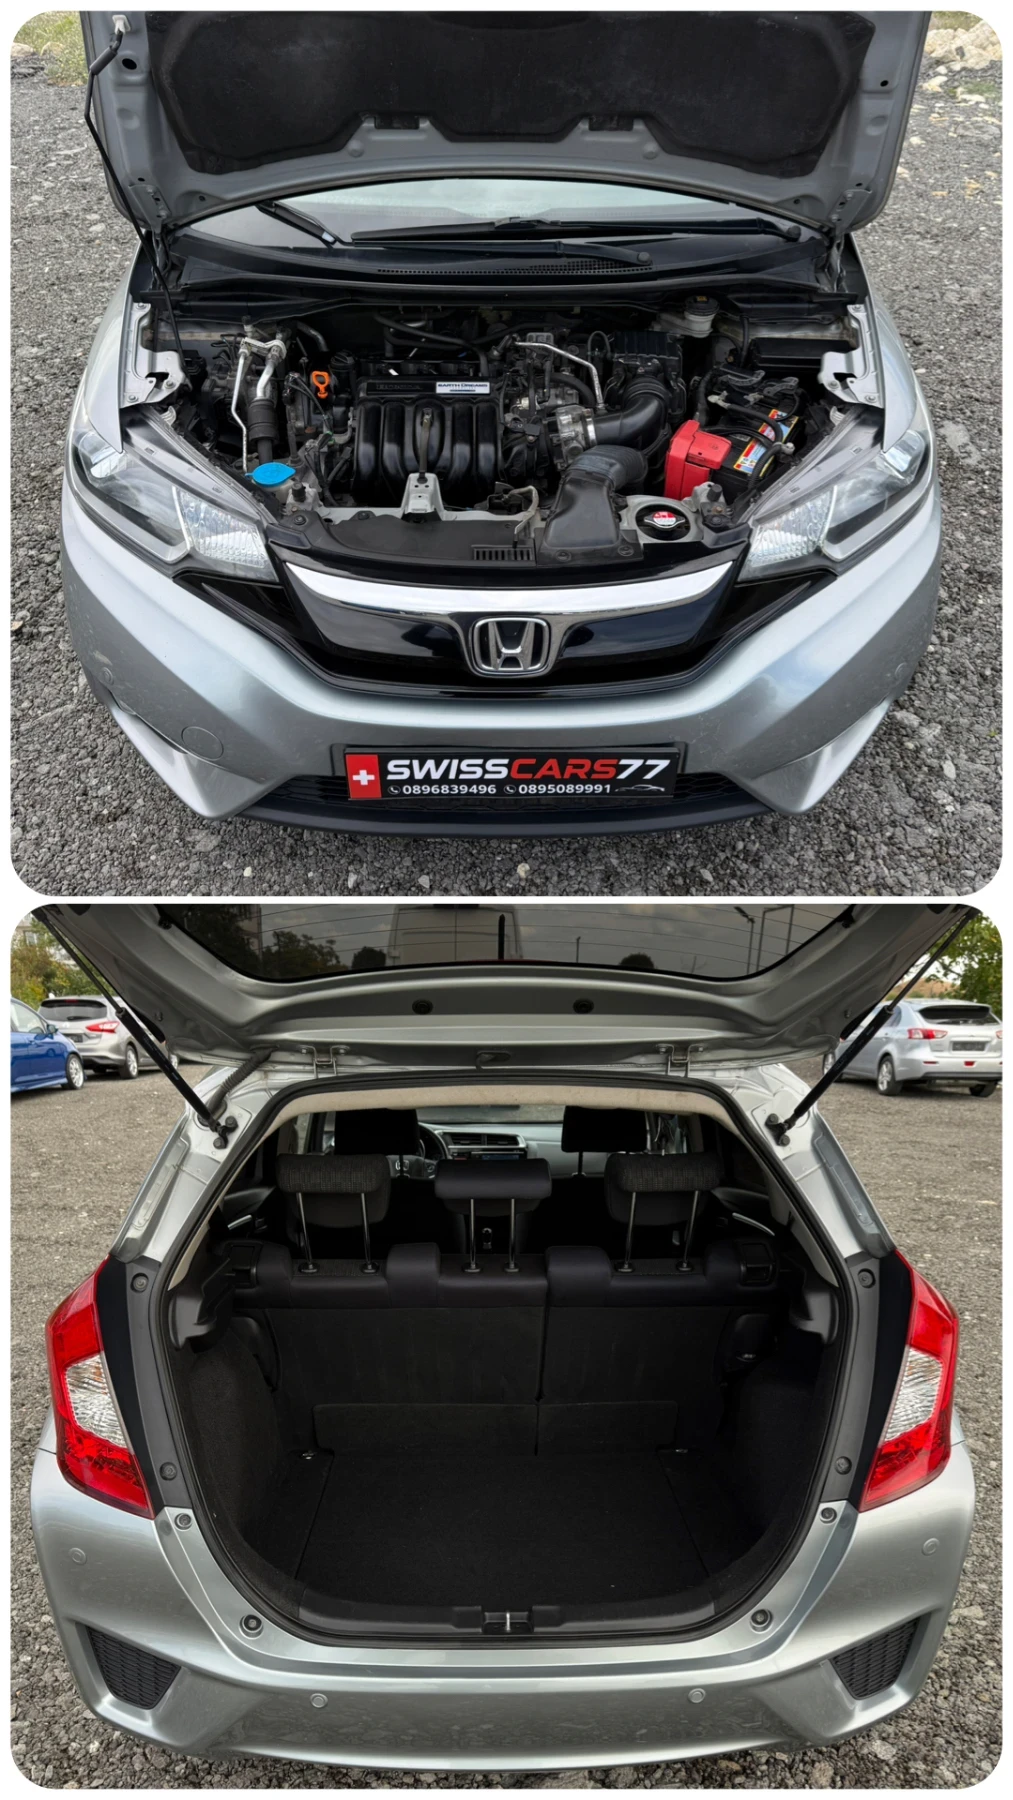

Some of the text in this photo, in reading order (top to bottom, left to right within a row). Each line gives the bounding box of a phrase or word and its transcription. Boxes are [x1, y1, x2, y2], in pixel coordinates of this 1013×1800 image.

[386, 758, 671, 780] SWISSCARS77
[402, 784, 611, 795] 0896839496 0895089991
